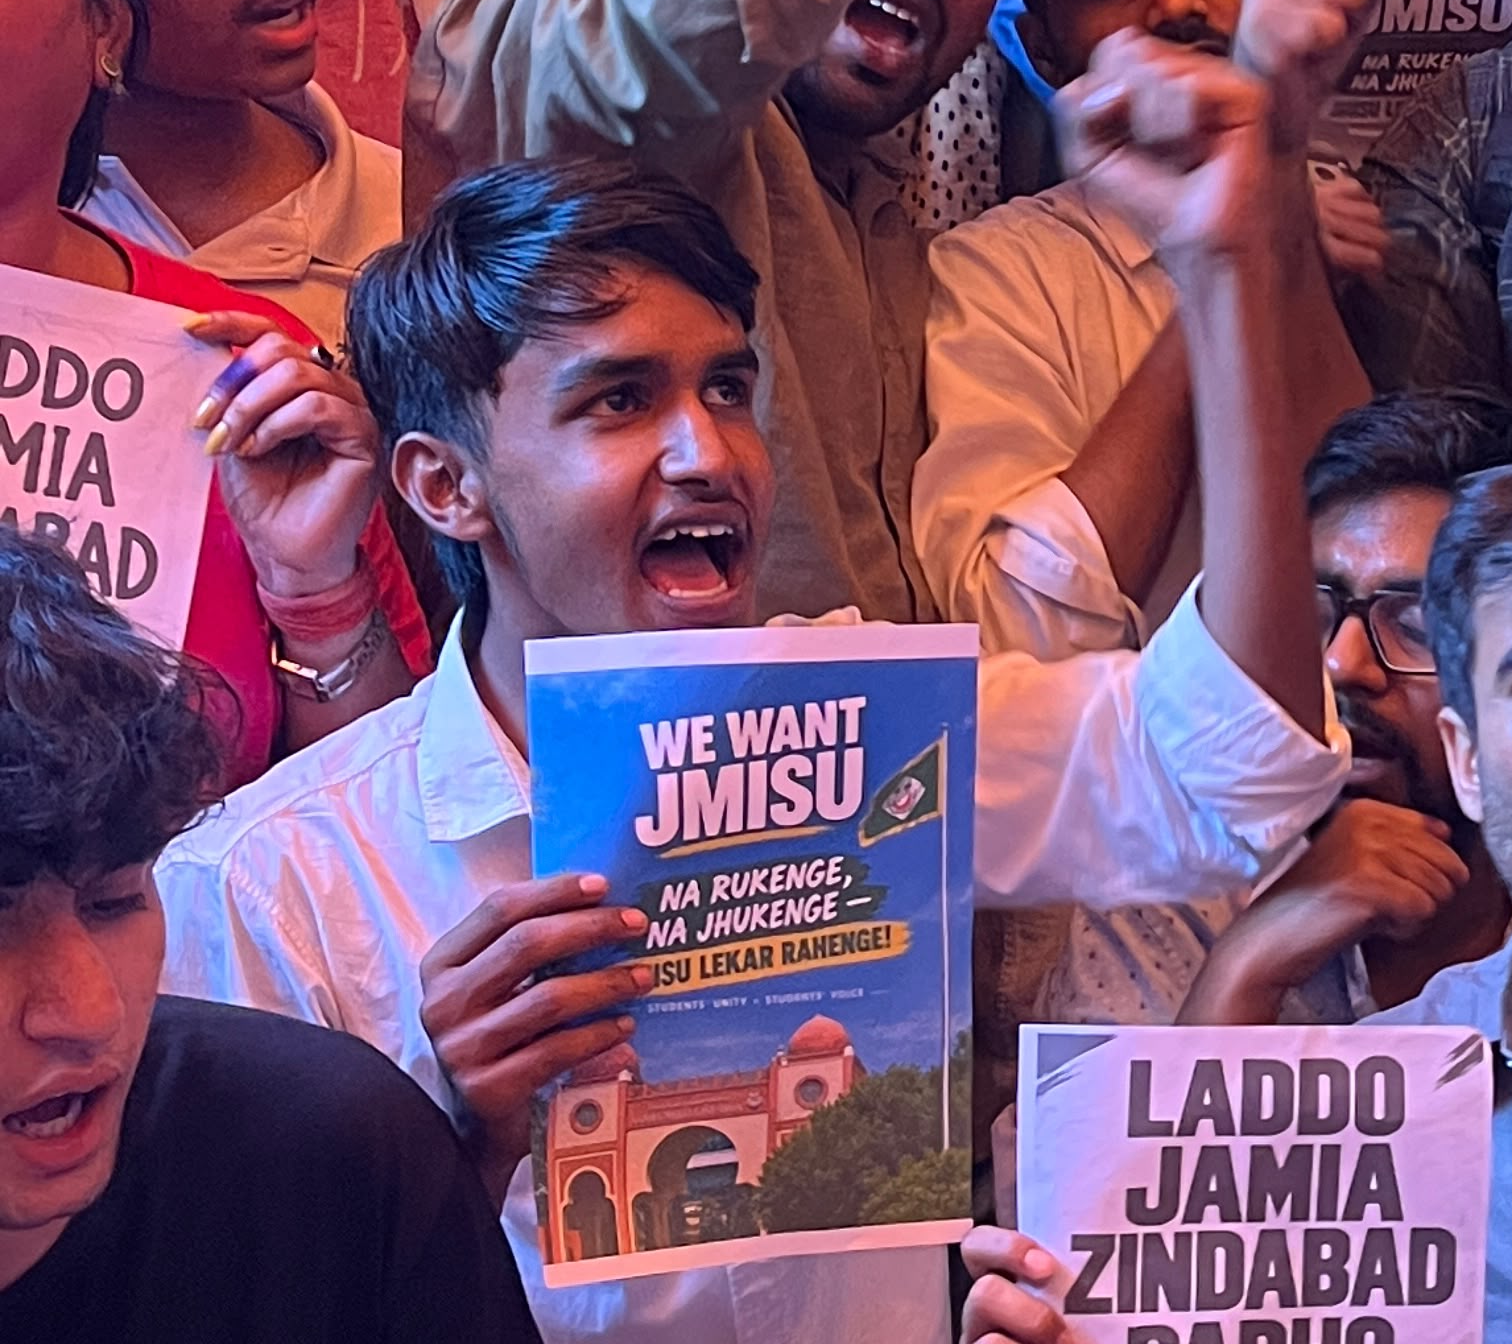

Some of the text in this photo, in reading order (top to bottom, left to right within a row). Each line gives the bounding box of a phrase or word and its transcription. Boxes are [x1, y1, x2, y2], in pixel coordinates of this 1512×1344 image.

[1350, 72, 1431, 92] NA JHU
[1361, 54, 1390, 70] NA
[639, 696, 867, 770] WE WANT
[635, 746, 864, 847] JMISU
[659, 856, 853, 913] NA RUKENGE,
[646, 917, 687, 950] NA
[697, 891, 839, 943] JHUKENGE
[700, 942, 774, 980] LEKAR
[782, 924, 892, 966] RAHENGE!
[1126, 1055, 1406, 1138] LADDO
[1125, 1143, 1404, 1227] JAMIA
[1063, 1227, 1457, 1315] ZINDABAD
